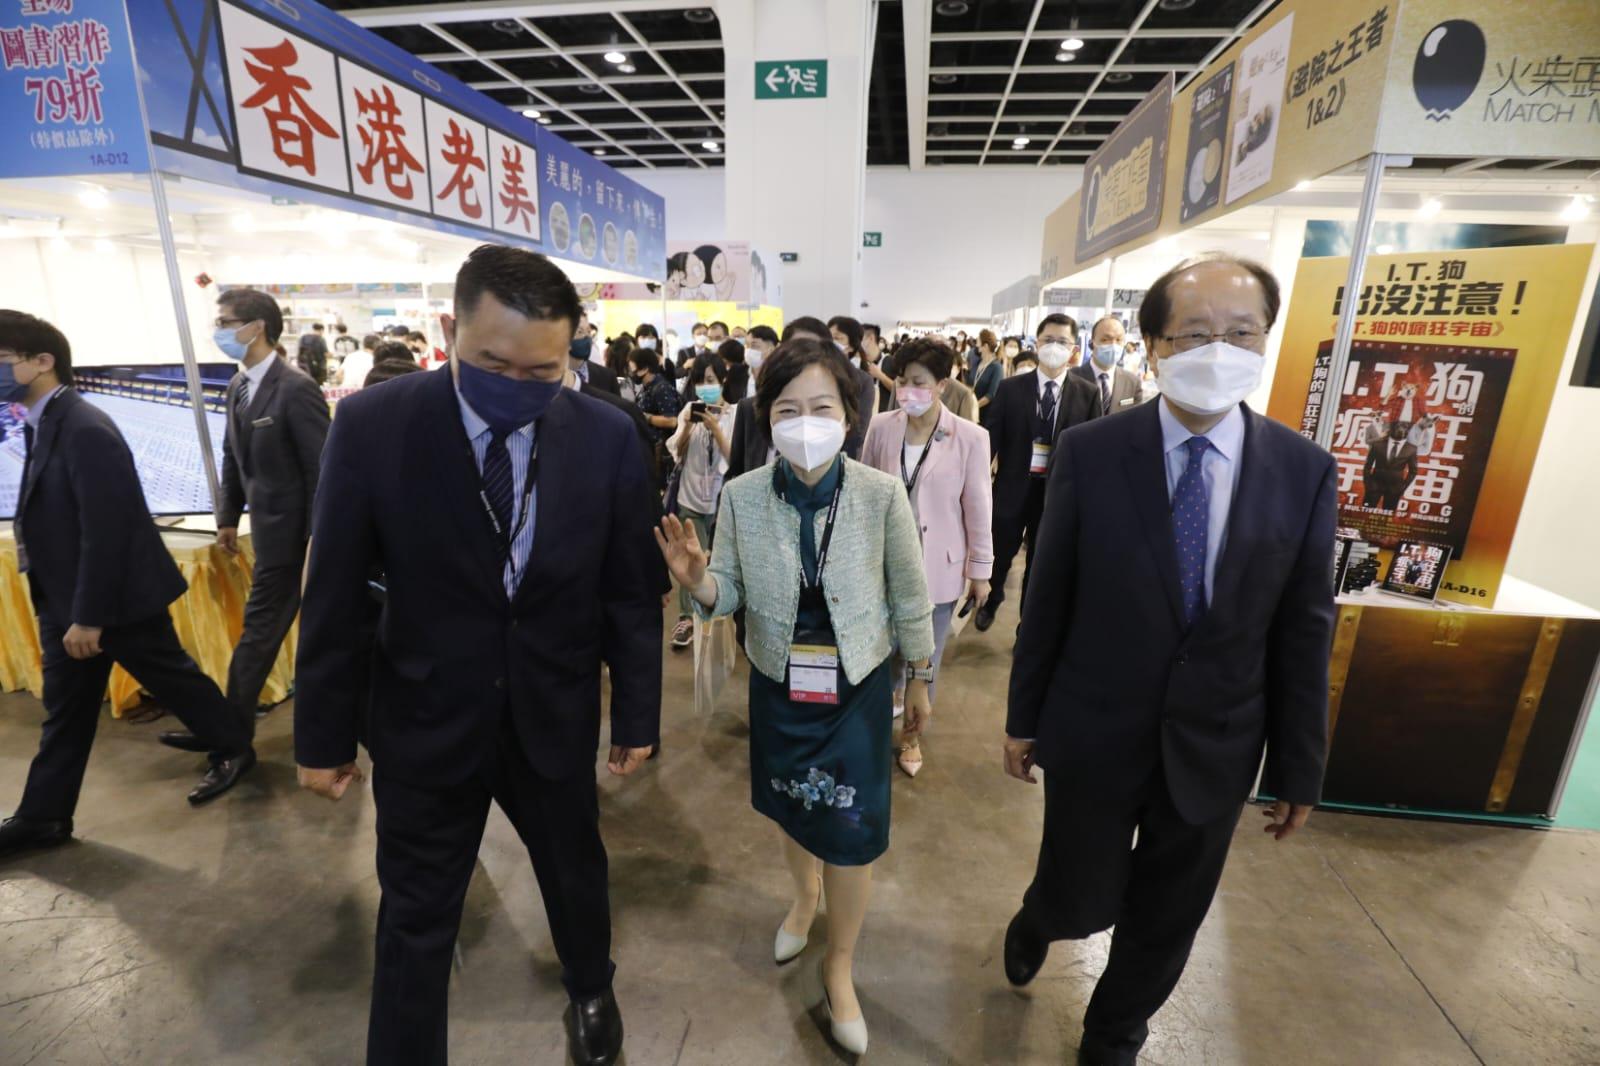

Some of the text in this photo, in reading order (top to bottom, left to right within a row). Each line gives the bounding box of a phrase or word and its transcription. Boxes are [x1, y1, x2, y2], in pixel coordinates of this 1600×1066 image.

[25, 66, 102, 123] 79折
[1483, 98, 1575, 122] MATCH
[240, 37, 536, 234] 香港老美
[90, 151, 129, 166] 1A-D12
